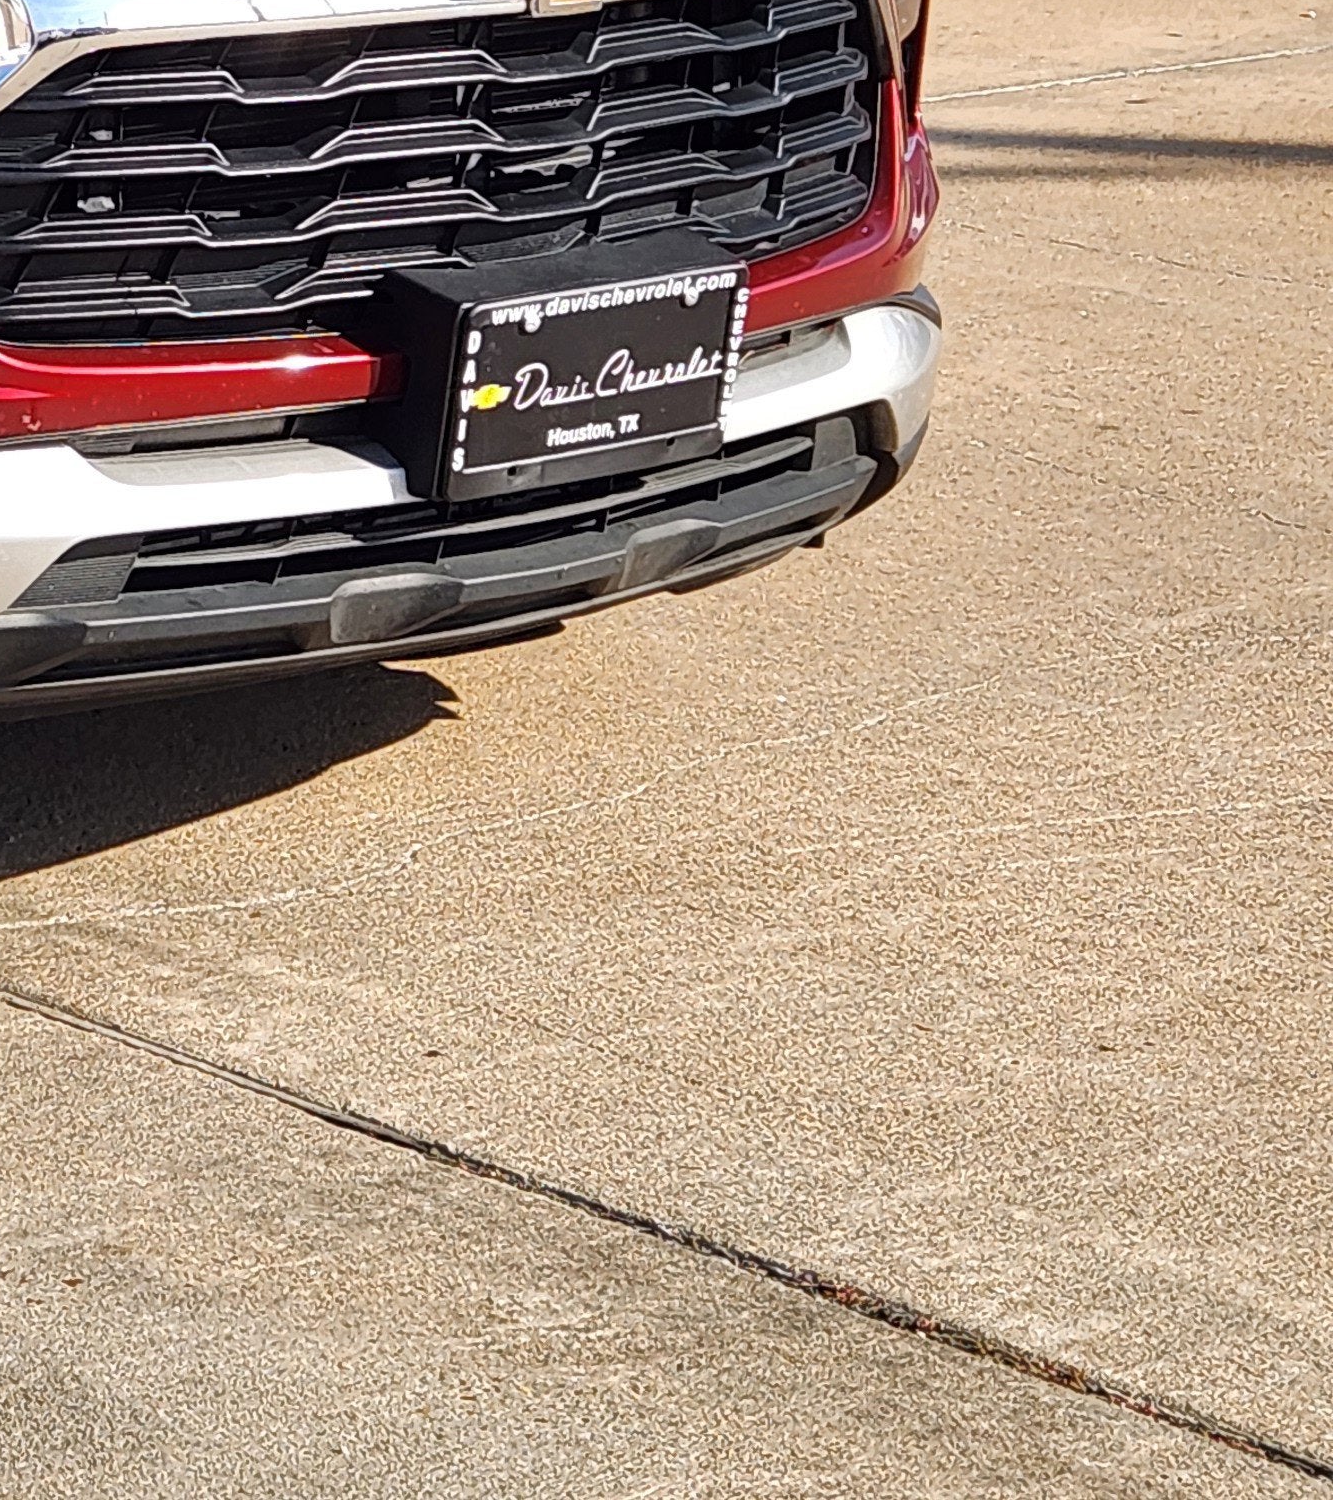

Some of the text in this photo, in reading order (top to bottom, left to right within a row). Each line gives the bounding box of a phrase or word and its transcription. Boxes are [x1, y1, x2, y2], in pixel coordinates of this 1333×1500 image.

[491, 271, 737, 326] www.davischevrolet.com
[451, 329, 483, 472] DAVIS
[513, 346, 722, 411] Davis Chevrolet
[546, 413, 640, 447] Houston, TX
